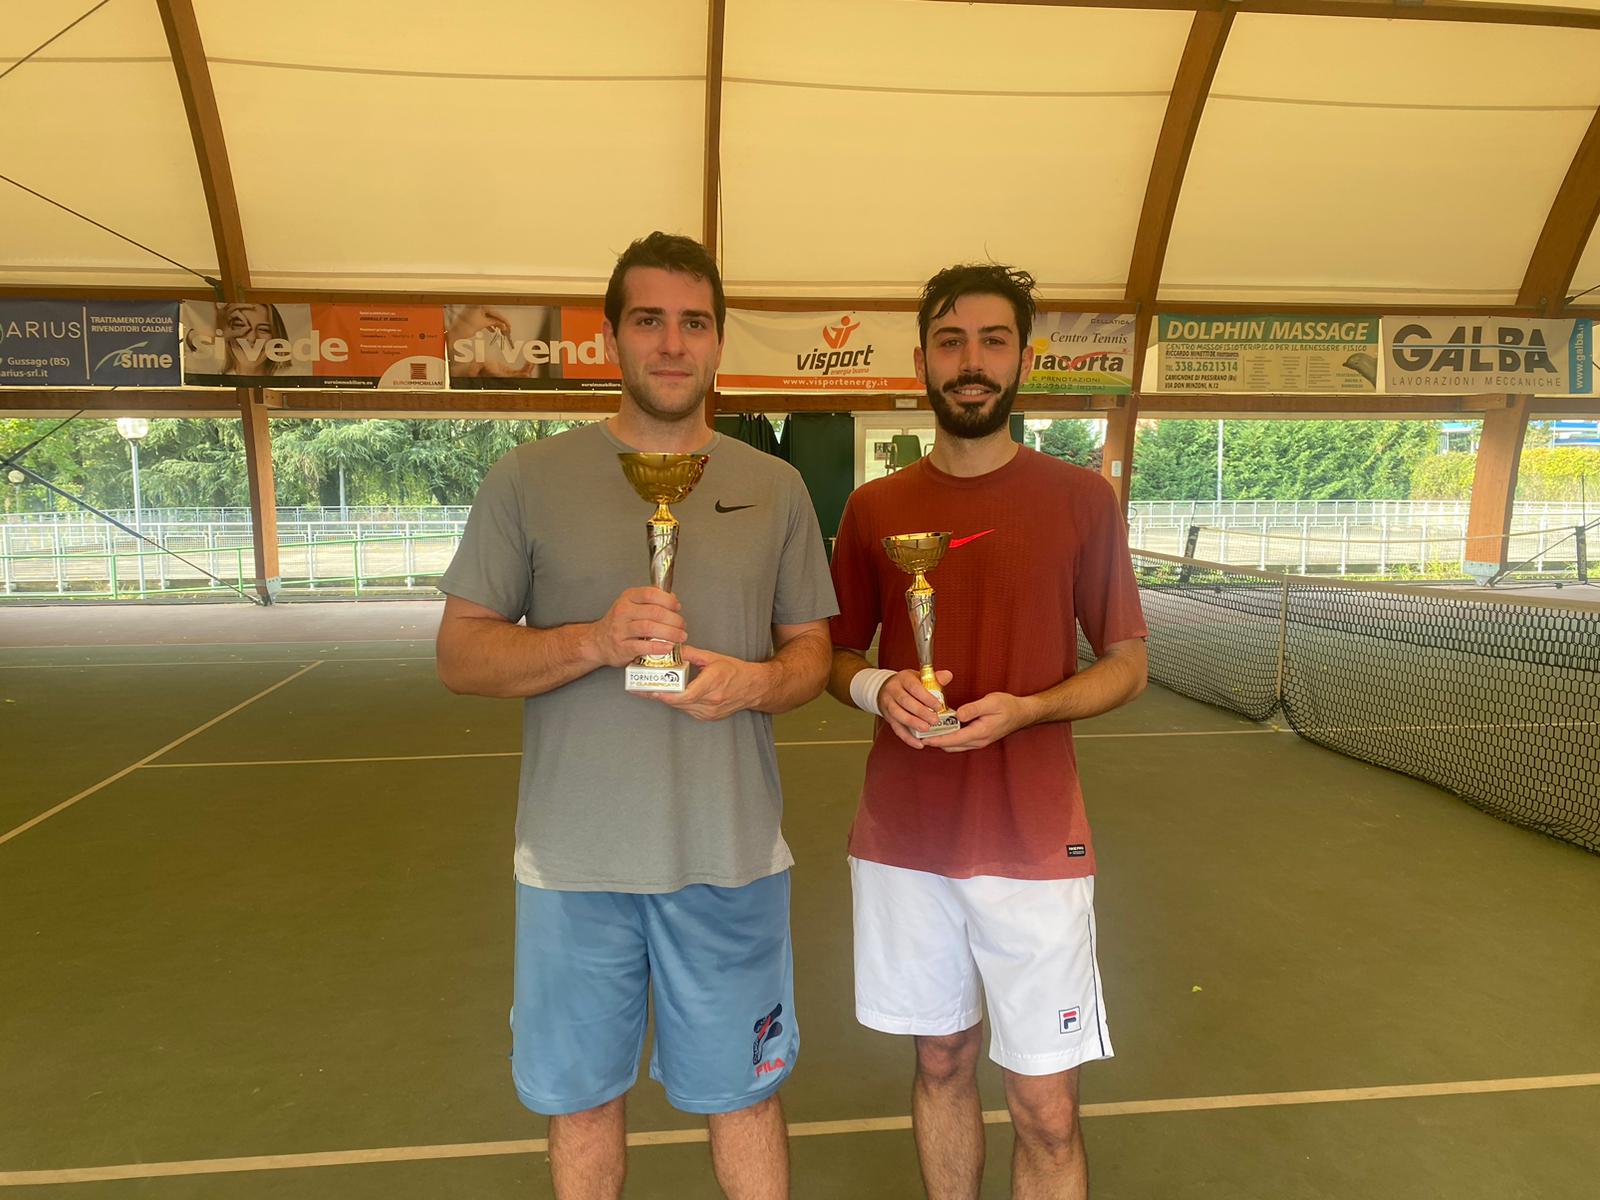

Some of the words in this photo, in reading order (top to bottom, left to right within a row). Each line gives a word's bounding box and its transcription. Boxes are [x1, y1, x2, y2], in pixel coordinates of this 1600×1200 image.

[91, 316, 143, 324] TRATTAMENTO
[145, 317, 173, 325] ACQUA
[141, 325, 174, 333] CALDAIE
[1167, 320, 1265, 340] DOLPHIN
[1270, 321, 1370, 341] MASSAGE
[190, 328, 226, 361] si
[236, 329, 349, 362] vede
[1050, 331, 1088, 343] Centro
[1092, 332, 1129, 344] Tennis
[453, 331, 485, 363] si
[500, 333, 610, 365] vend
[1392, 324, 1558, 373] GALBA
[7, 356, 48, 368] Gussago
[50, 356, 70, 367] (BS)
[121, 351, 173, 369] sime
[797, 344, 874, 376] visport
[1575, 323, 1585, 389] www.galba.it
[1175, 361, 1239, 372] 338.2621314
[783, 378, 889, 389] www.visportenergy.it
[1041, 375, 1100, 383] PRENOTAZIONI
[1392, 376, 1475, 386] LAVORAZIONI
[1484, 376, 1561, 387] MECCANICHE
[755, 1057, 785, 1078] FILA
